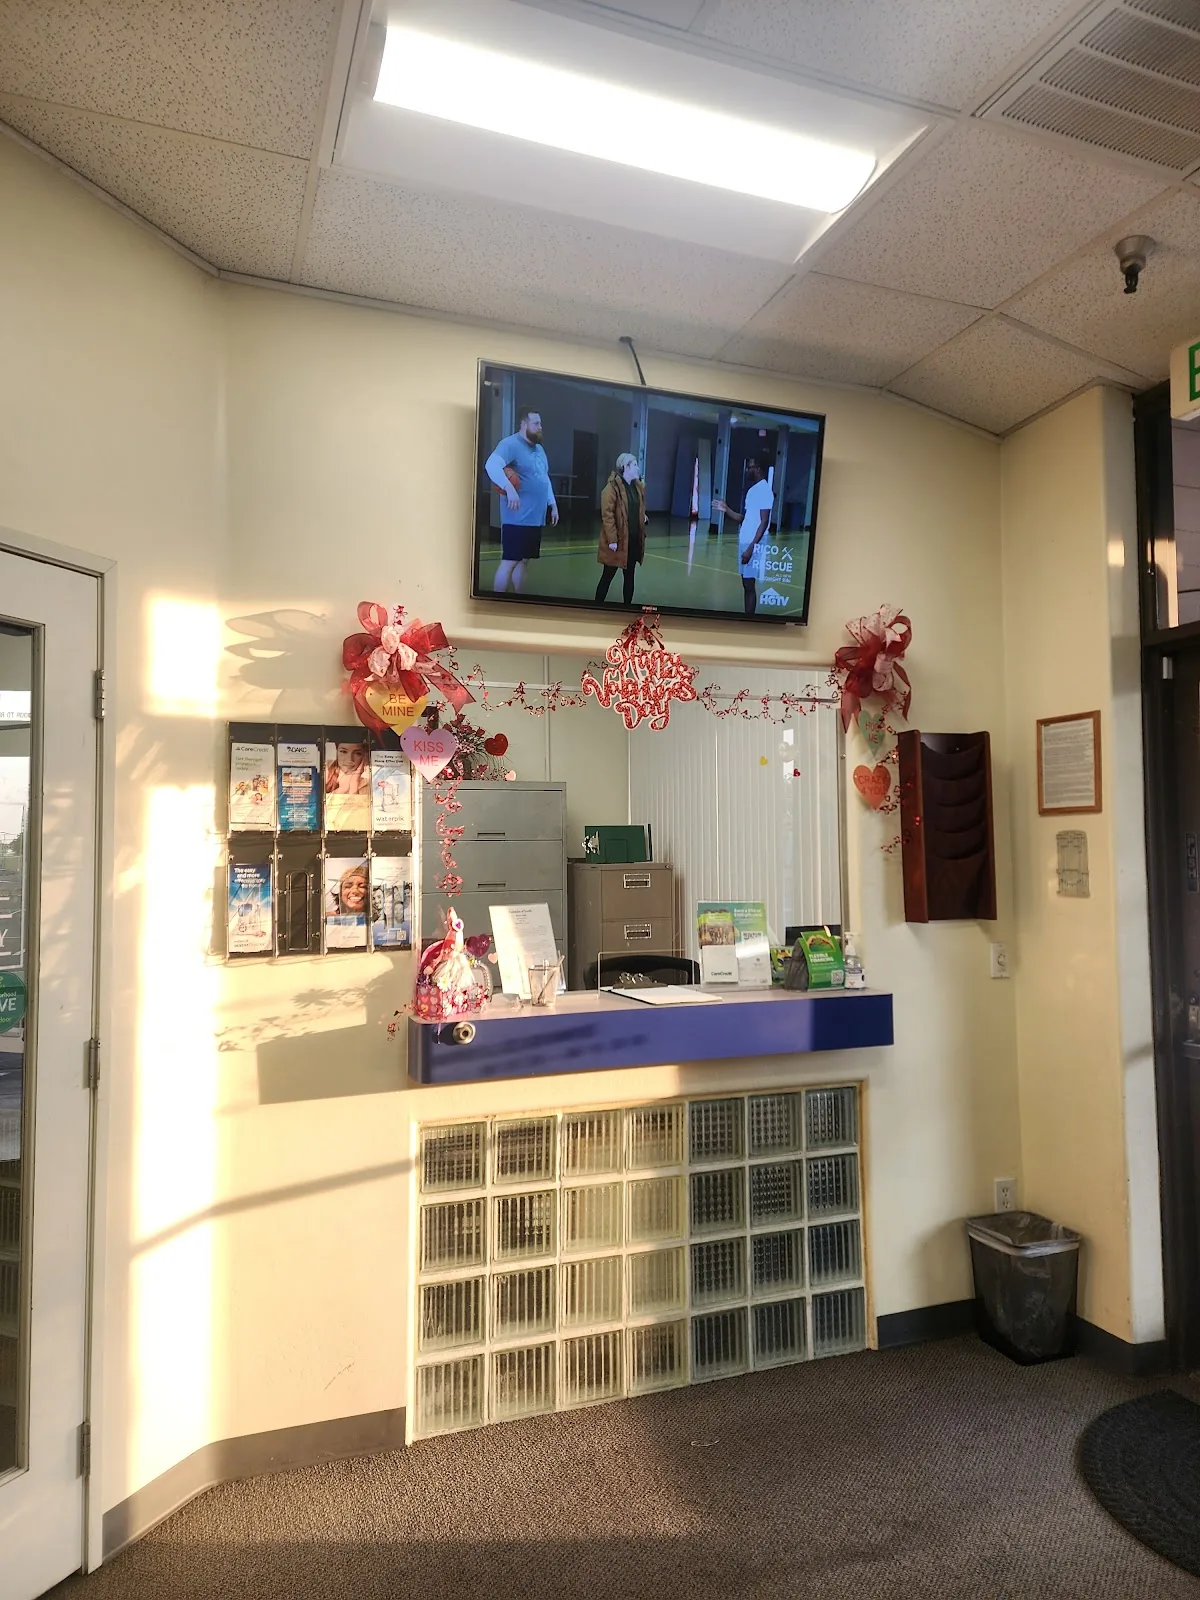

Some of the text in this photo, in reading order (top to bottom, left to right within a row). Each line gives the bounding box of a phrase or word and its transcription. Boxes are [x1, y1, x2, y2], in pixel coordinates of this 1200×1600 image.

[753, 543, 779, 555] RICO
[752, 559, 793, 573] RSCUE
[759, 594, 790, 607] HGTV
[389, 693, 407, 704] BE
[382, 705, 415, 717] MINE
[614, 698, 670, 731] Day
[413, 740, 444, 753] KISS
[419, 754, 440, 766] ME
[858, 775, 888, 785] CRAZY
[861, 785, 888, 796] 4 YOU
[375, 815, 405, 823] waterpik
[1187, 837, 1197, 879] PUSH
